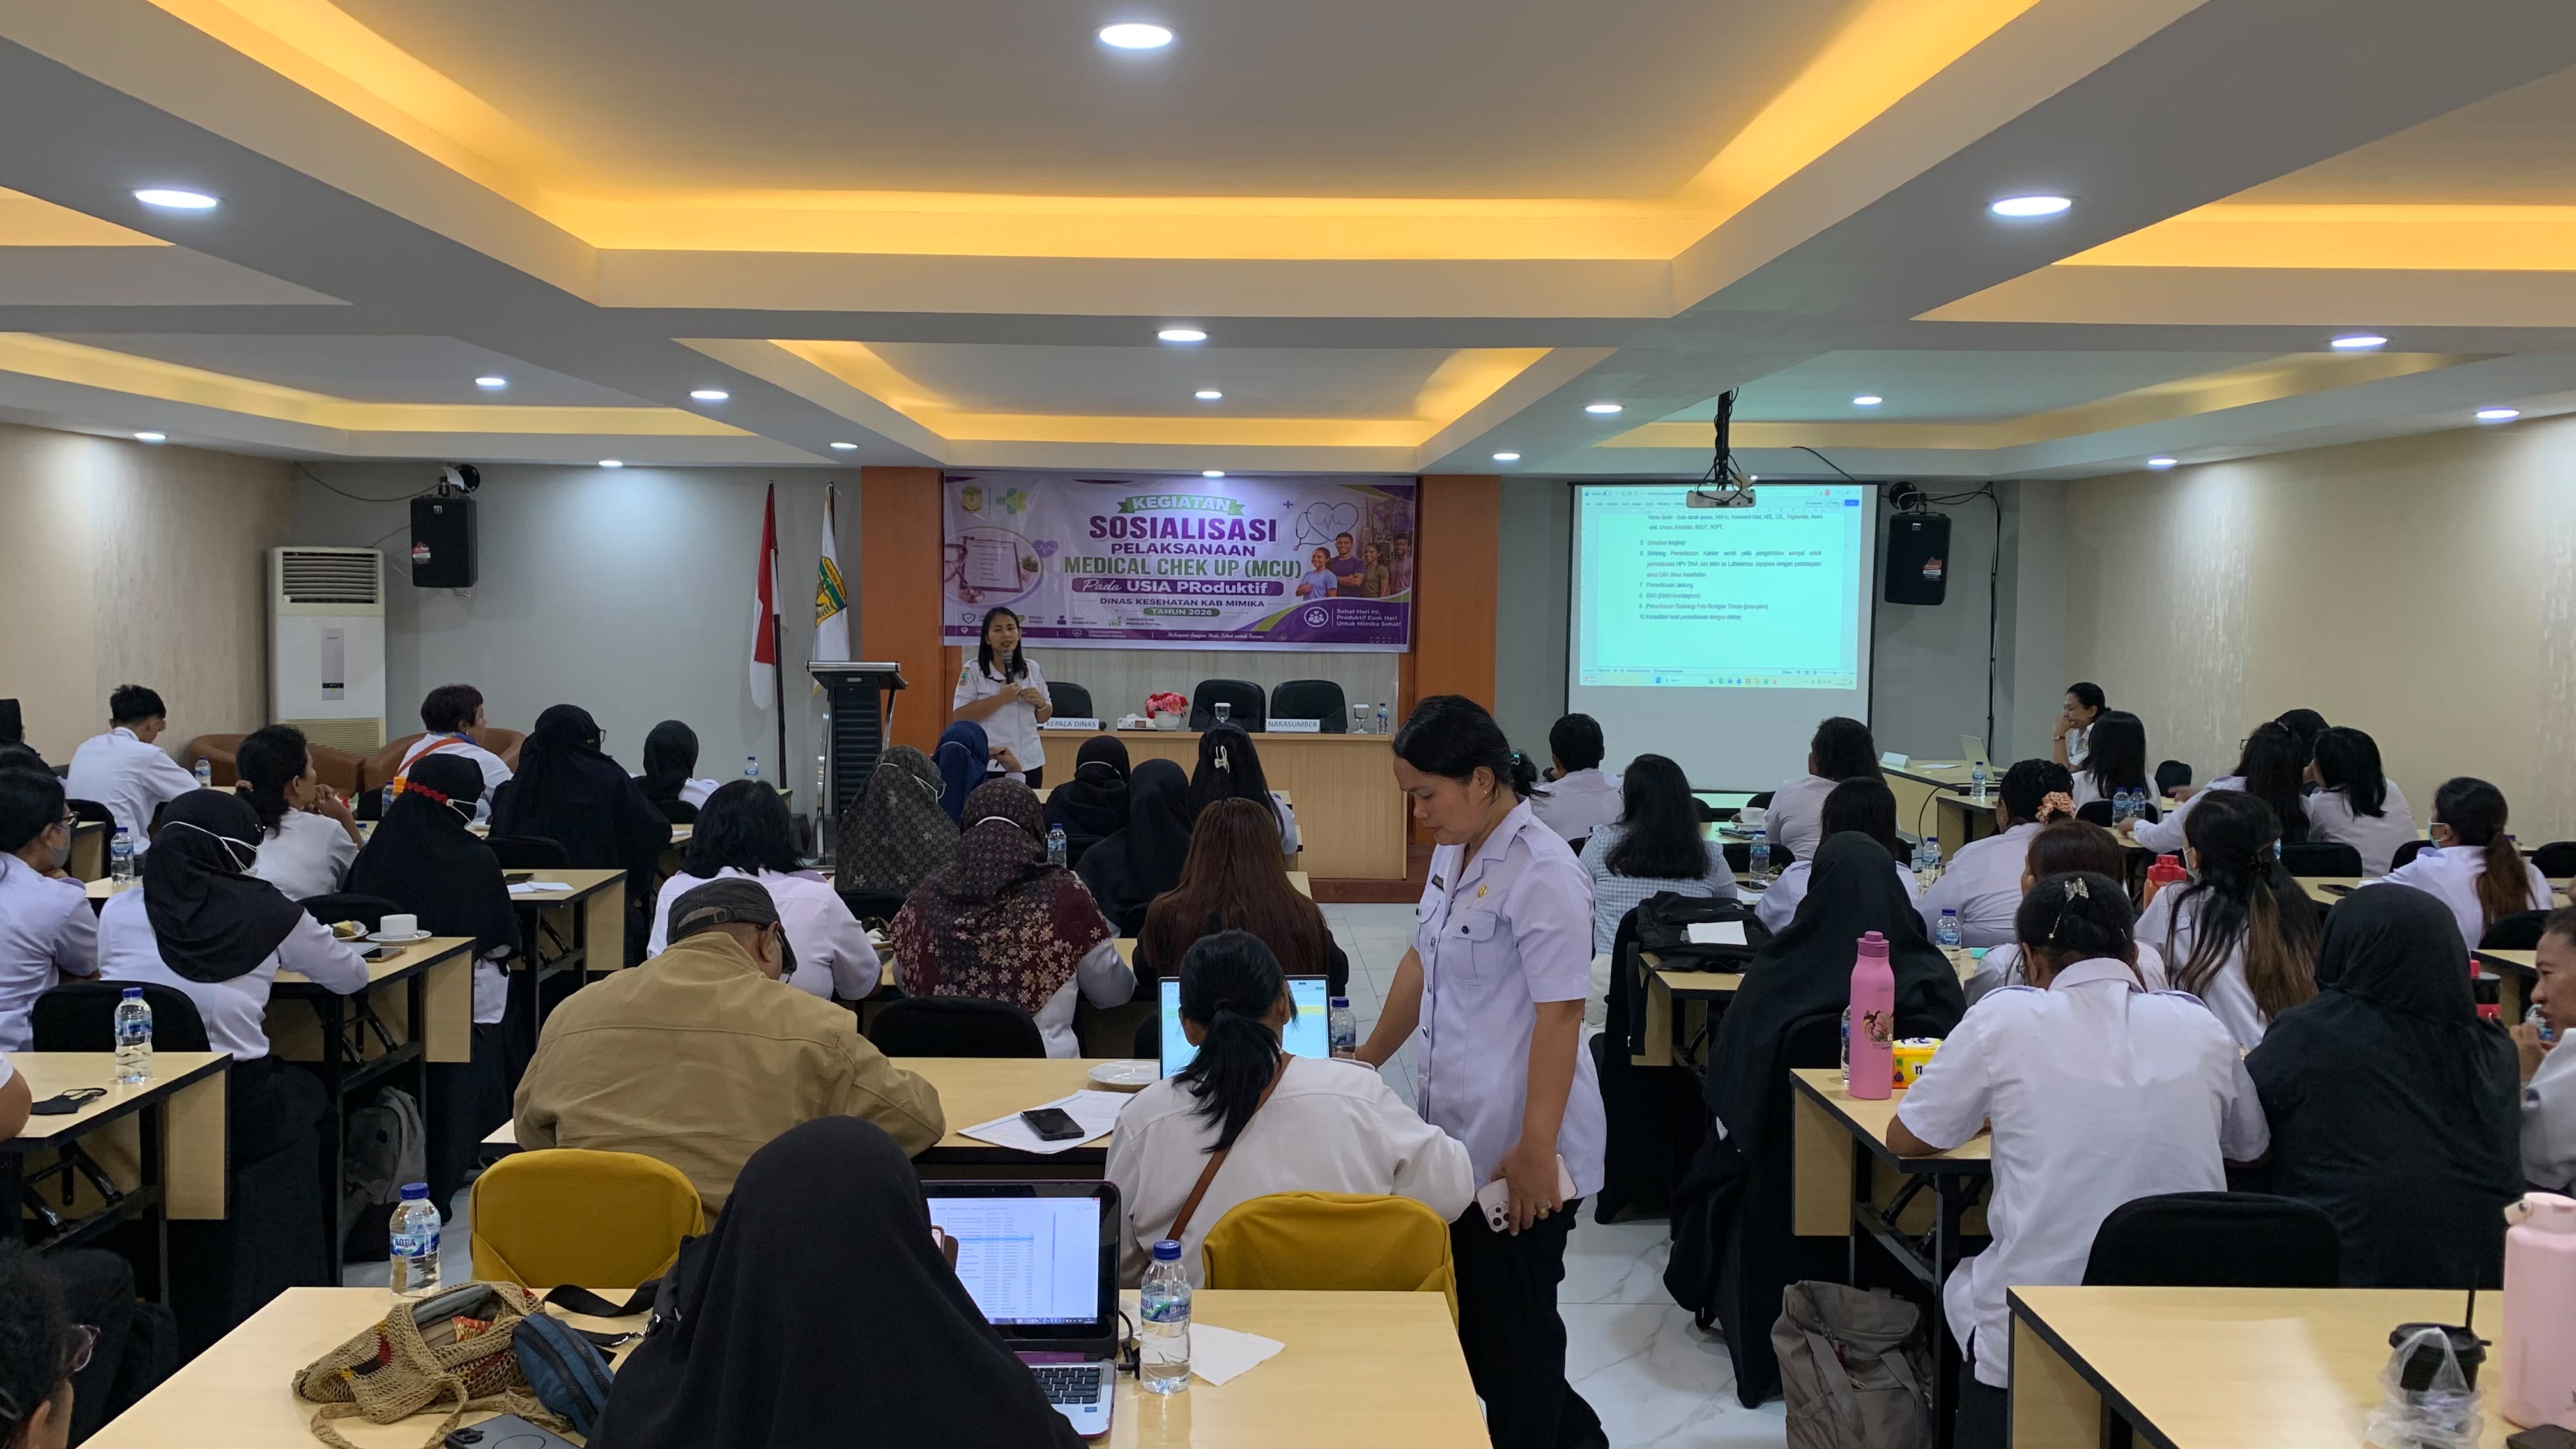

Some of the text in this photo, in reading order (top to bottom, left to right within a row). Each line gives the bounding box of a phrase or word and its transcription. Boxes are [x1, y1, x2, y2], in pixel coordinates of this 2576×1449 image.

[1133, 496, 1230, 512] KEGIATAN
[1089, 515, 1276, 542] SOSIALISASI
[1111, 543, 1256, 556] PELAKSANAAN
[1064, 556, 1301, 578] MEDICAL CHEK UP (MCU)
[1083, 578, 1268, 594] Pada USIA PRoduktif
[394, 1238, 416, 1248] AQUA
